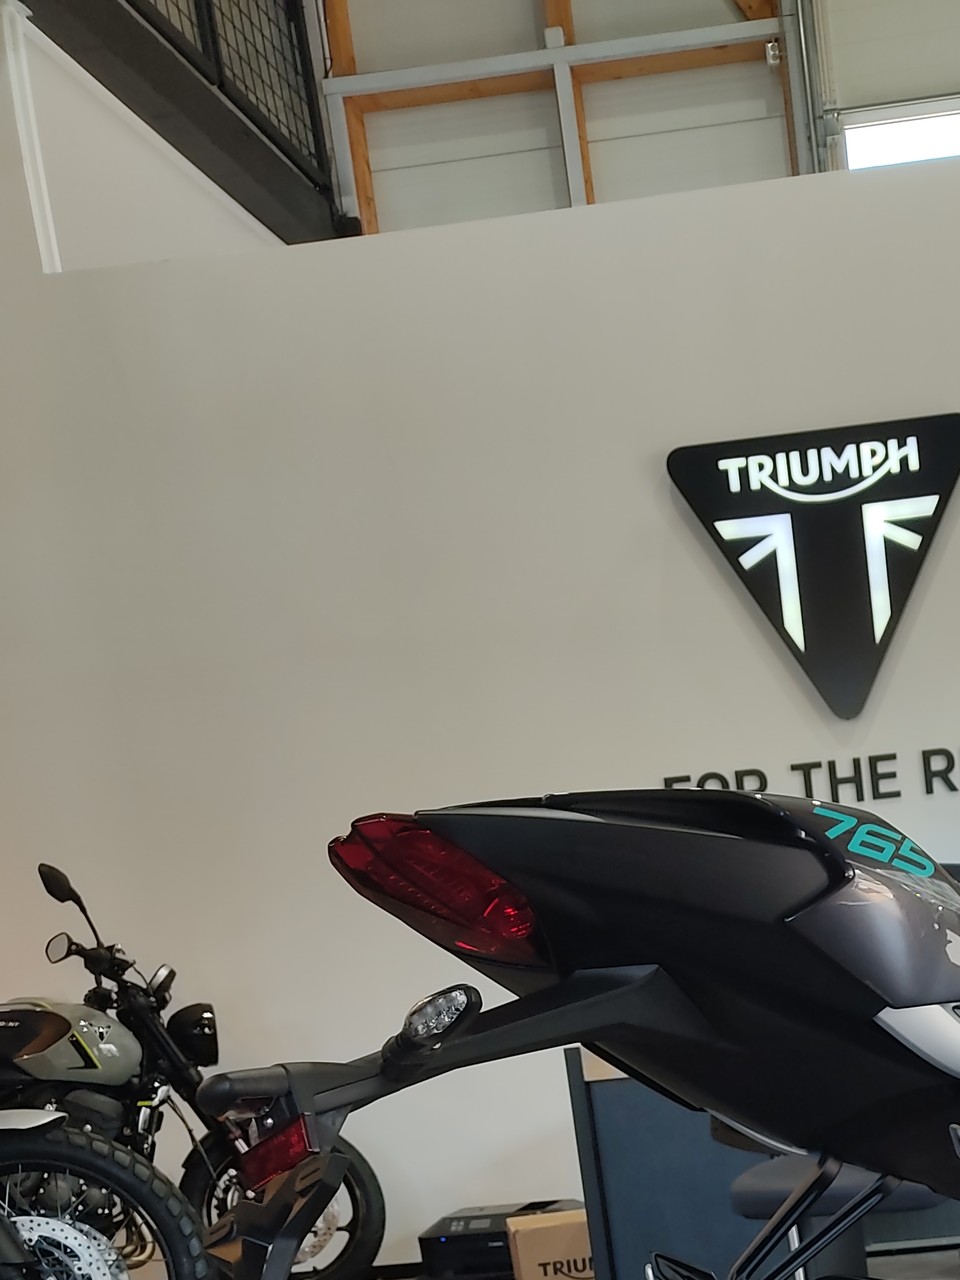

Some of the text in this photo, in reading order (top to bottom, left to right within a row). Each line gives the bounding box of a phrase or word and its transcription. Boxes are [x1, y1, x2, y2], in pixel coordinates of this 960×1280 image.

[717, 436, 920, 502] TRIUMPH
[790, 752, 901, 803] THE
[812, 806, 936, 879] 765
